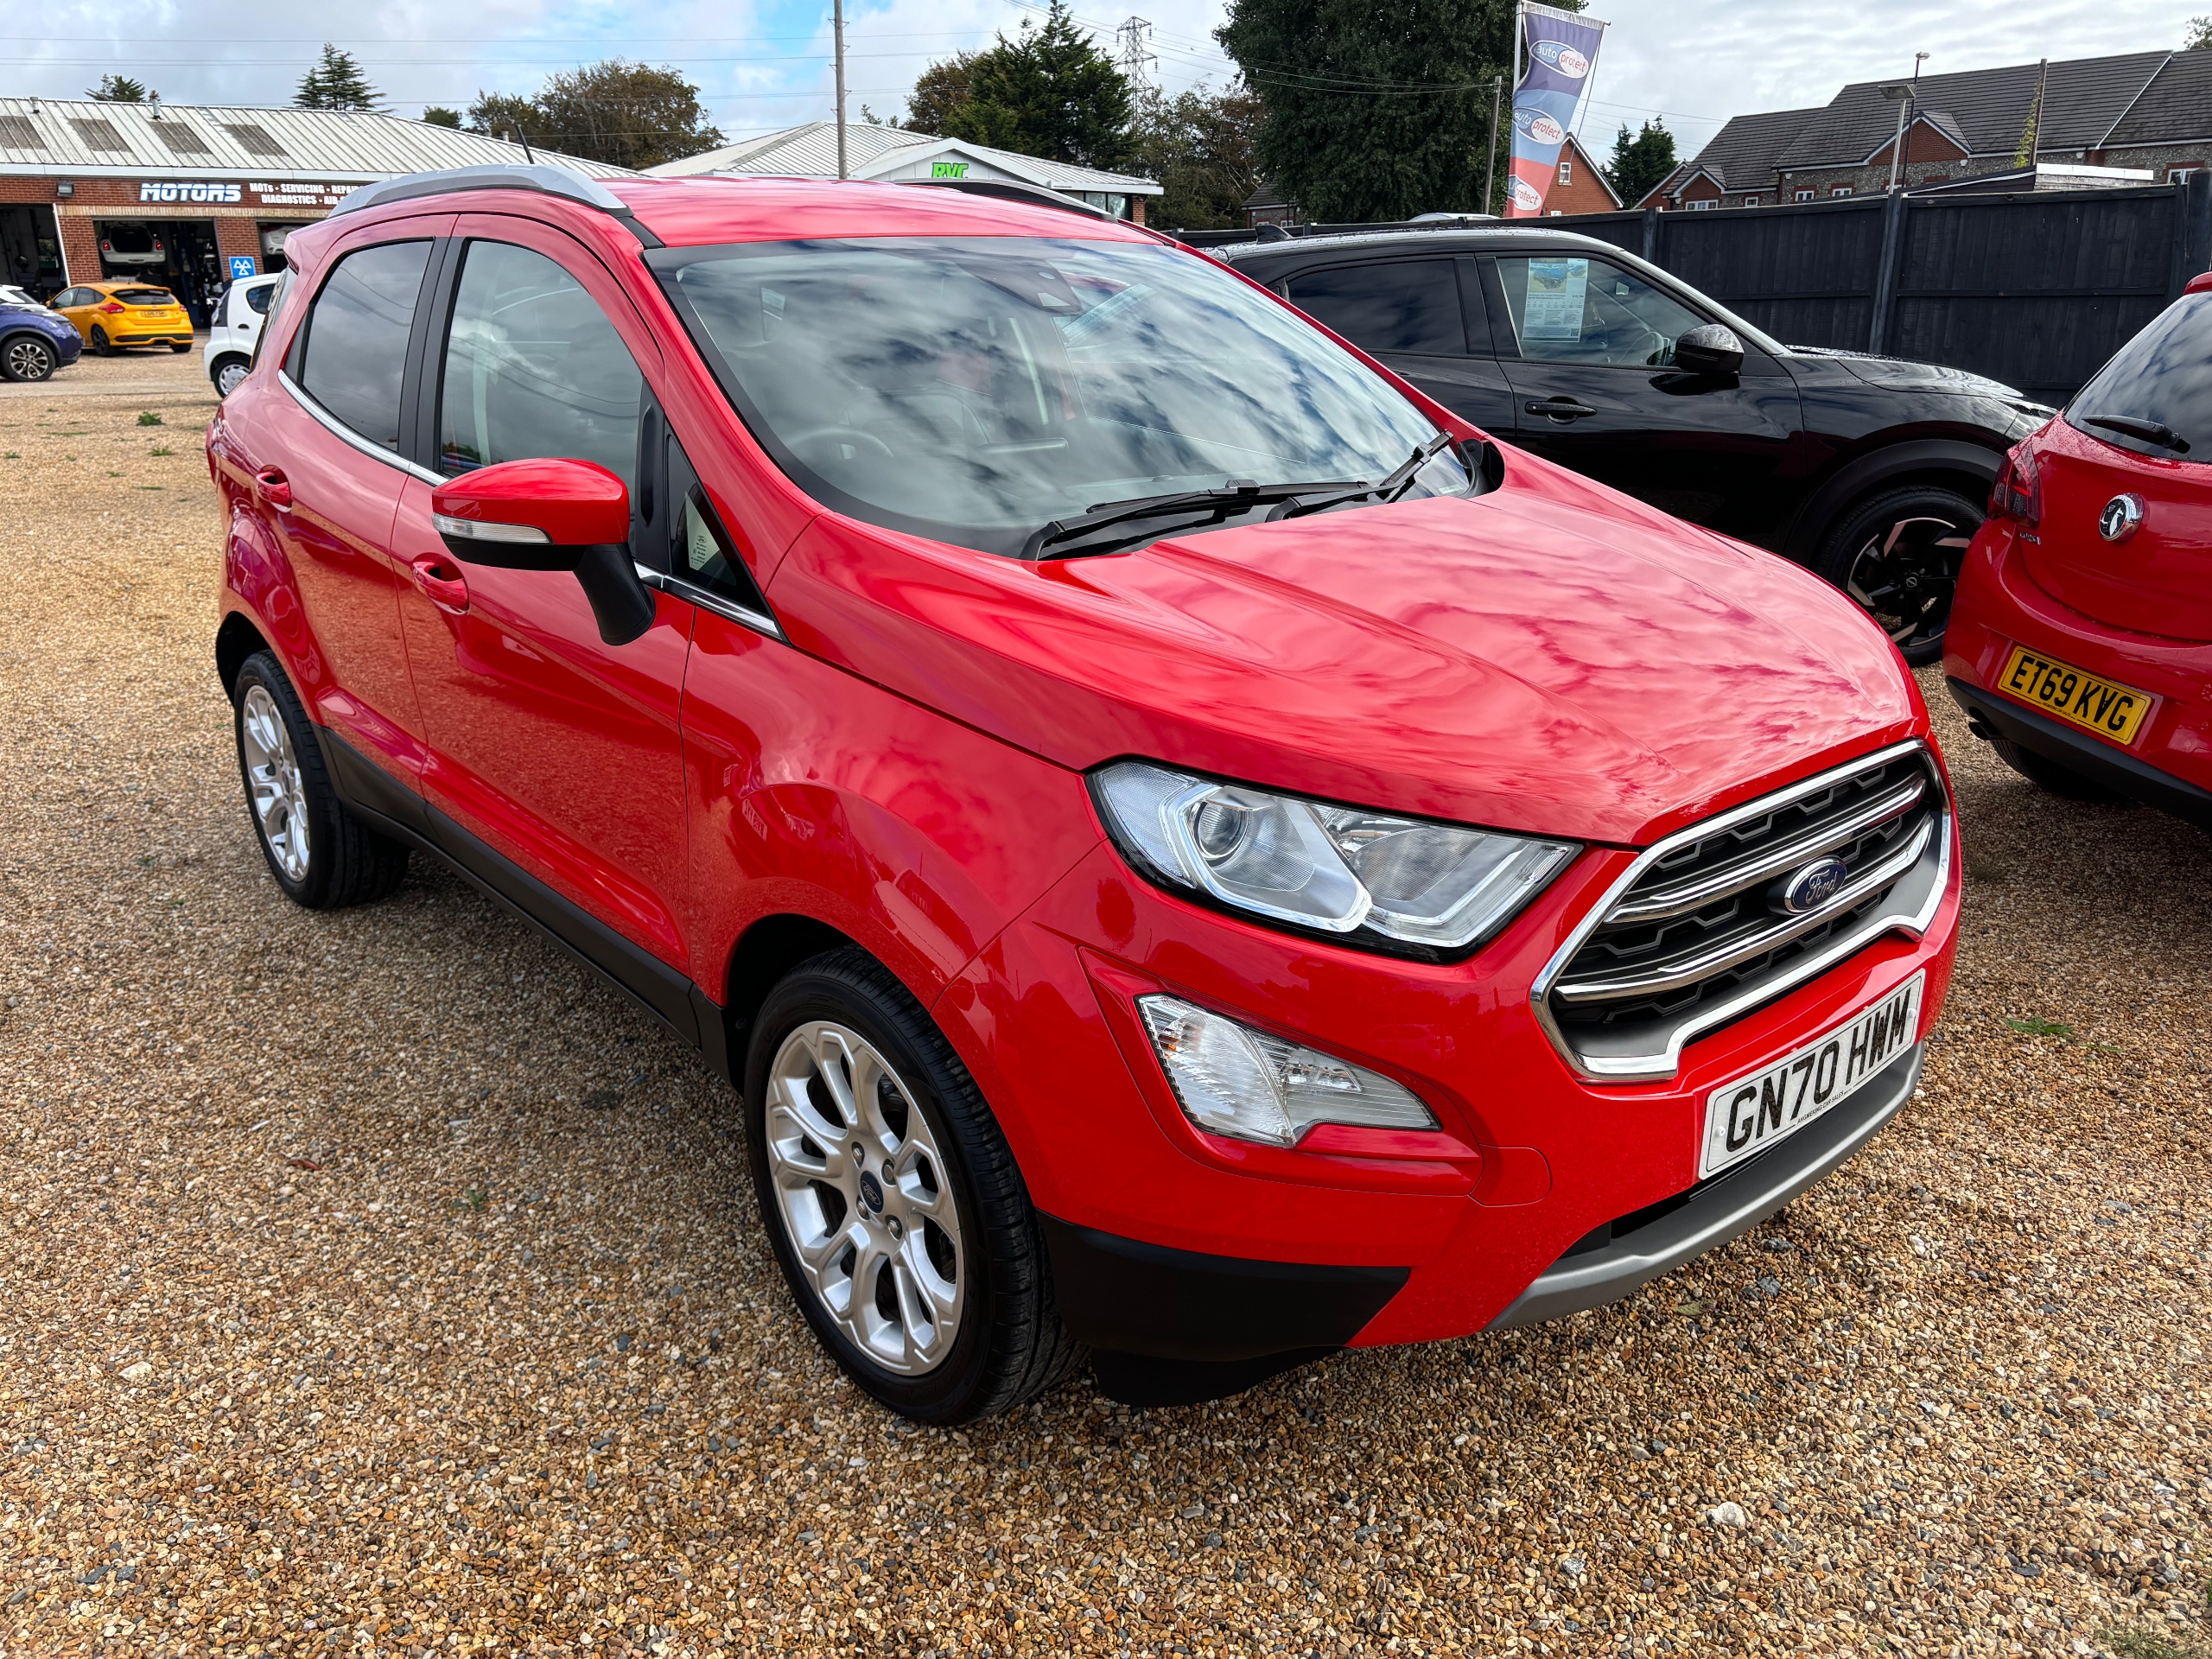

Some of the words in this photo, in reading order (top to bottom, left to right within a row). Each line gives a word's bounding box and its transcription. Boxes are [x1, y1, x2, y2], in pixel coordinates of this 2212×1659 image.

[1536, 45, 1557, 59] auto
[1560, 54, 1586, 73] protect
[1514, 111, 1532, 125] auto
[1533, 120, 1561, 140] protect
[139, 182, 242, 203] MOTORS
[249, 182, 274, 193] MOTs
[280, 183, 325, 194] SERVICING
[261, 194, 317, 205] DIAGNOSTICS
[323, 196, 346, 206] AIR-
[2009, 654, 2078, 708] ET69
[2073, 680, 2134, 732] KVG
[1806, 868, 1839, 904] Ford
[1726, 1039, 1840, 1153] GN70
[1845, 988, 1912, 1085] HWM
[1796, 1104, 1822, 1124] ANGMERING
[1822, 1099, 1832, 1109] CAR
[1831, 1090, 1844, 1103] SALES
